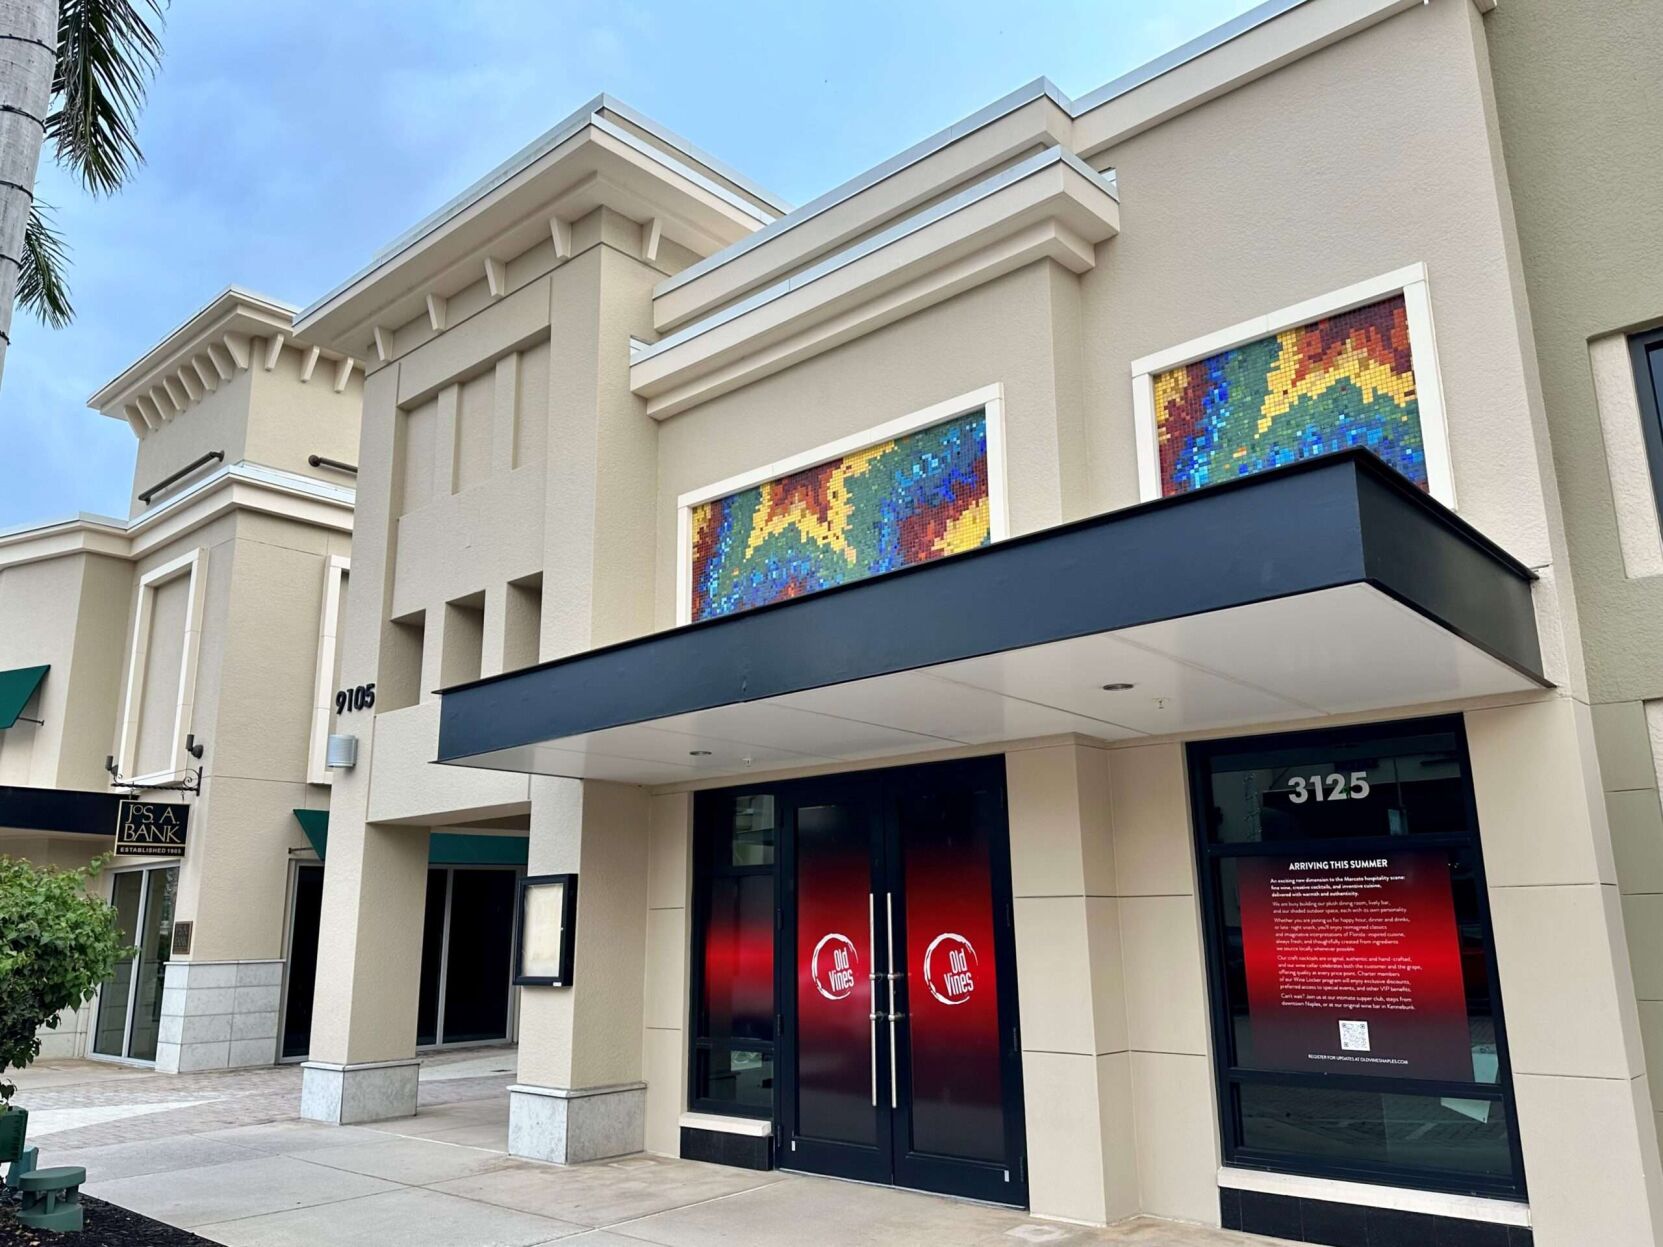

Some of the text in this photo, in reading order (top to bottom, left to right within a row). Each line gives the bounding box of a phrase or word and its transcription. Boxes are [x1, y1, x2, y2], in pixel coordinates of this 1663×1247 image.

[335, 683, 376, 716] 9105
[1287, 771, 1371, 804] 3125
[159, 806, 180, 824] A.
[123, 823, 181, 842] BANK
[1289, 859, 1388, 870] ARRIVING THIS SUMMER
[834, 947, 849, 971] Old
[949, 948, 968, 975] Old
[828, 969, 854, 992] Vines
[943, 971, 974, 996] Vines
